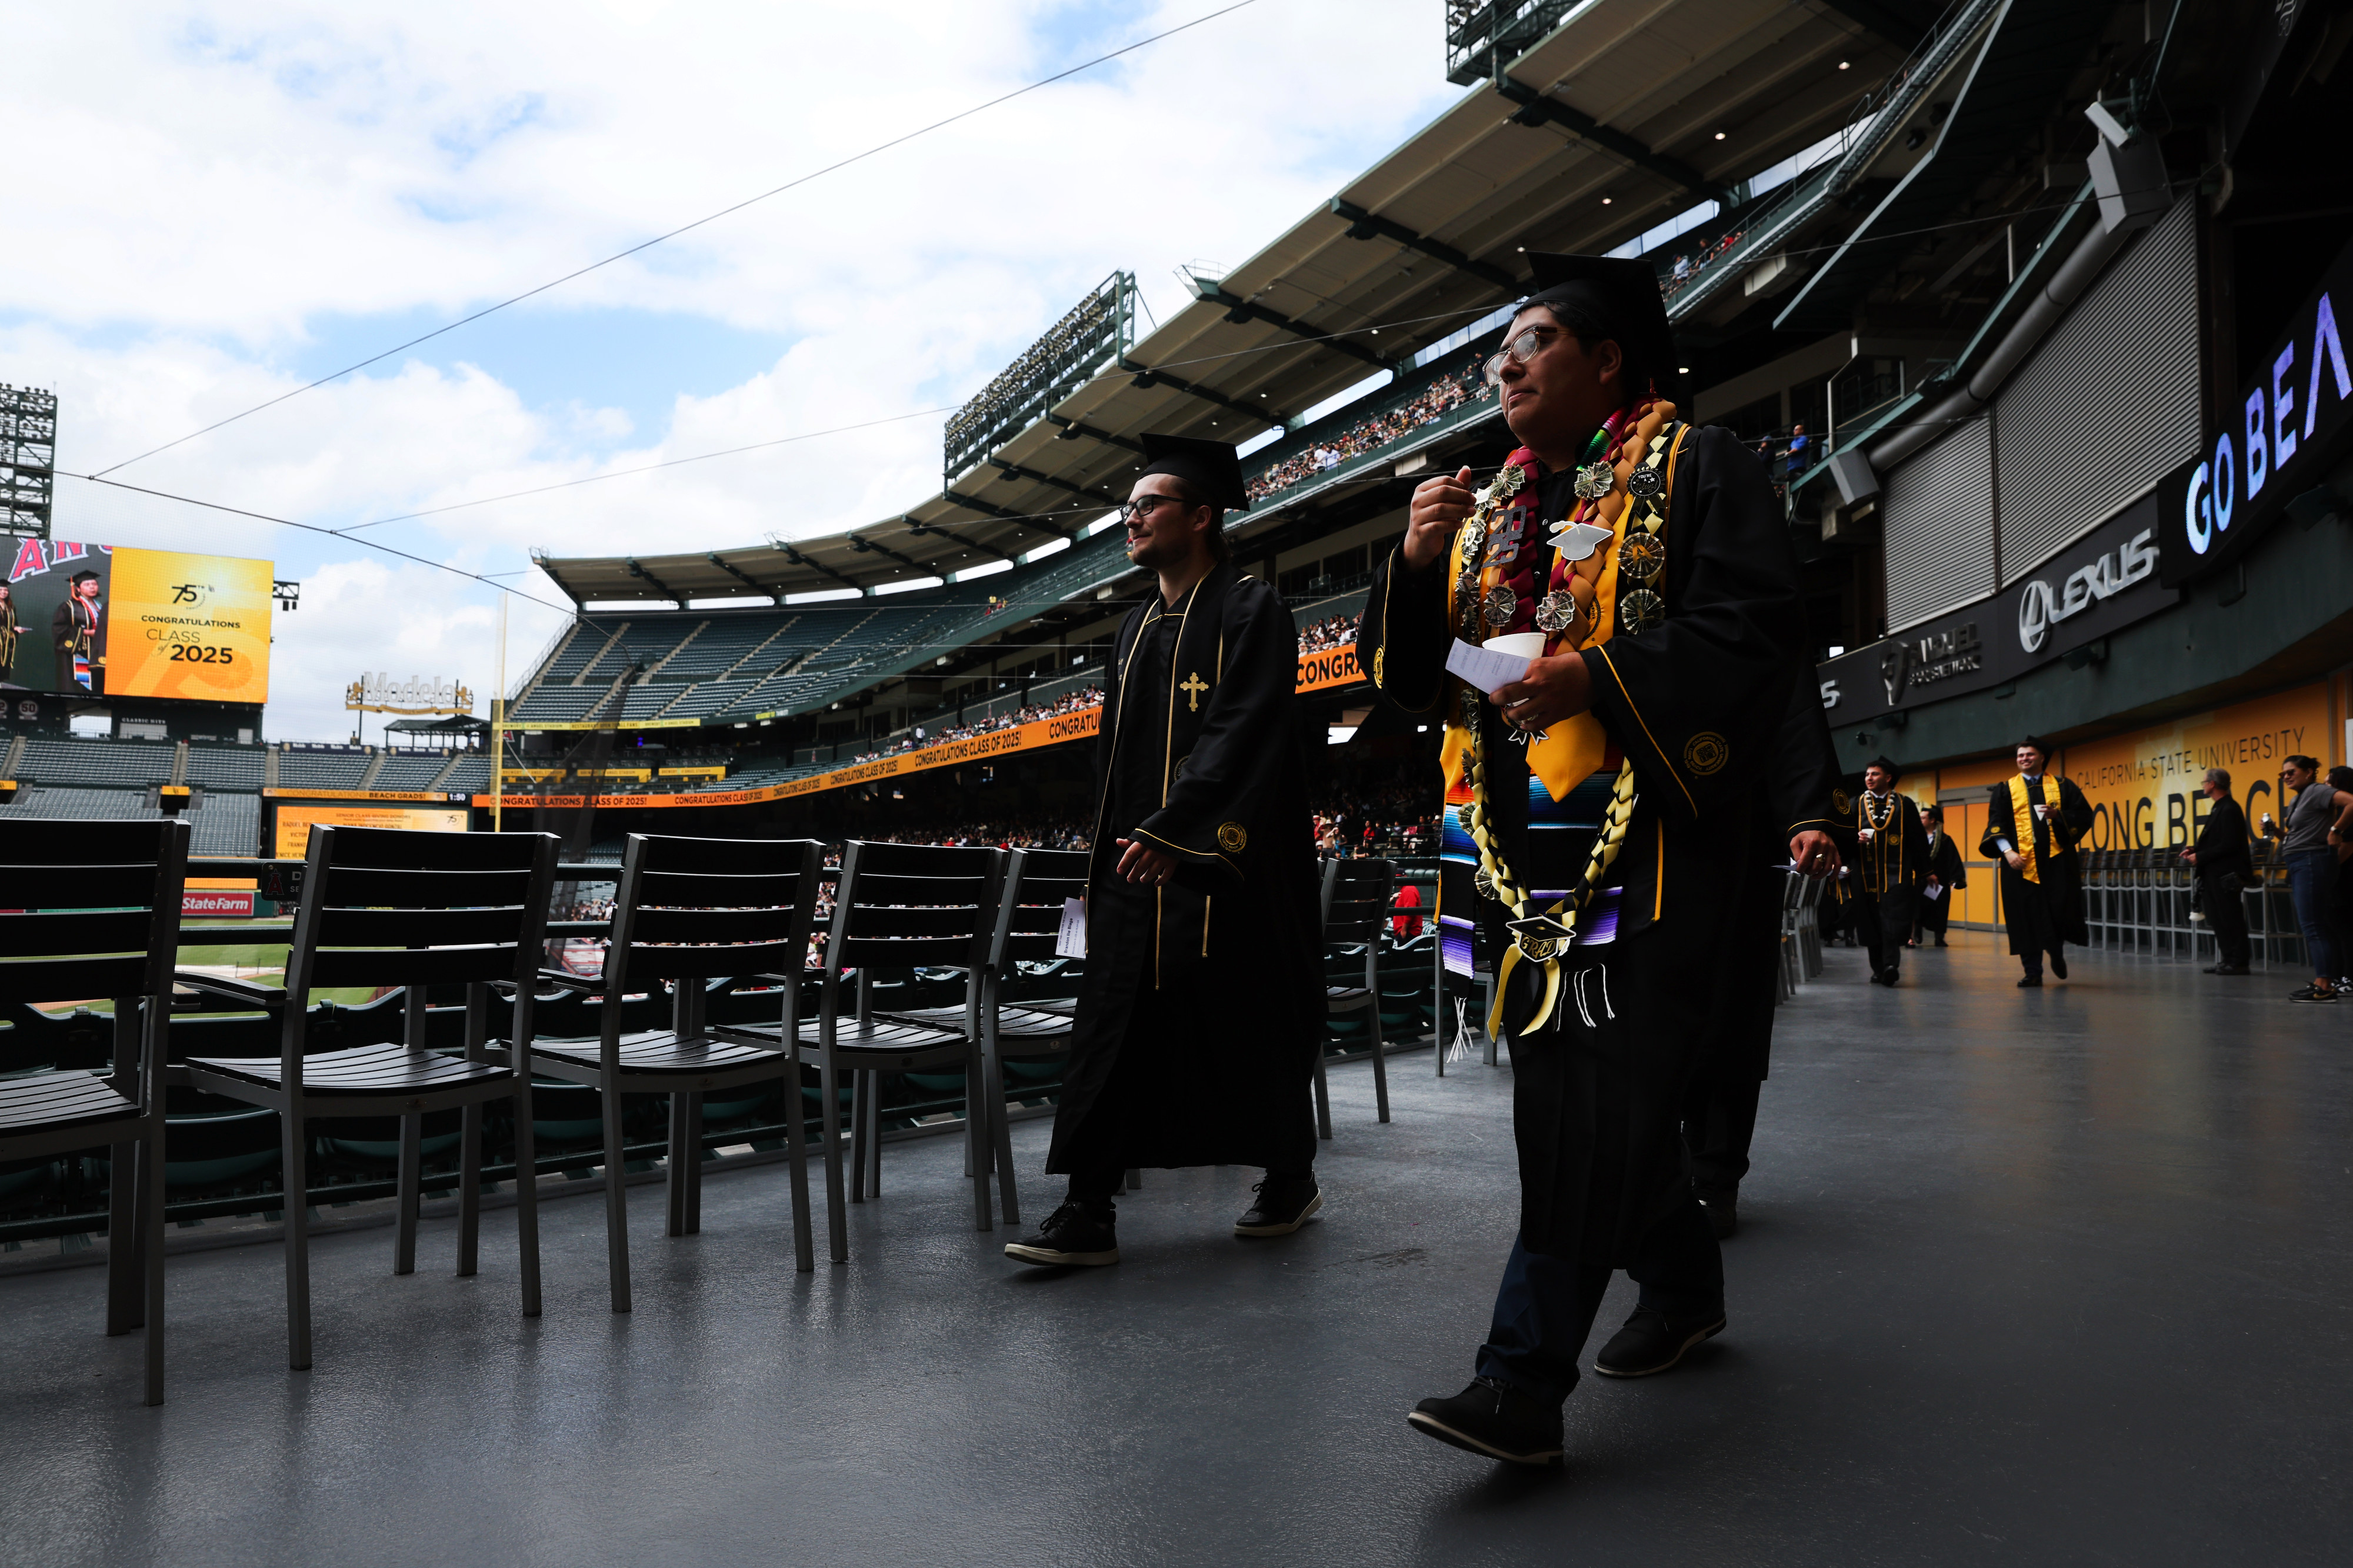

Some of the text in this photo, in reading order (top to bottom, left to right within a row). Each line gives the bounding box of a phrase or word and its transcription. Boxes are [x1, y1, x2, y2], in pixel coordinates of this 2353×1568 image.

[2186, 432, 2234, 555] GO
[8, 537, 112, 583] AN
[2045, 528, 2160, 625] LEXUS
[141, 615, 241, 629] CONGRATULATIONS
[146, 629, 200, 643] CLASS
[170, 644, 233, 664] 2025
[363, 671, 457, 704] Modelo
[21, 703, 36, 712] 50
[915, 730, 1022, 766] CONGRATULATIONS CLASS OF 2025!
[2077, 726, 2305, 790] CALIFORNIA STATE UNIVERSITY
[830, 760, 898, 785] CONGRATULATIONS CLASS OF 2025!
[613, 797, 624, 805] OF
[625, 797, 647, 805] 2025!
[675, 795, 732, 804] CONGRATULATIONS
[733, 793, 748, 802] CLASS
[1521, 936, 1556, 959] GRAD
